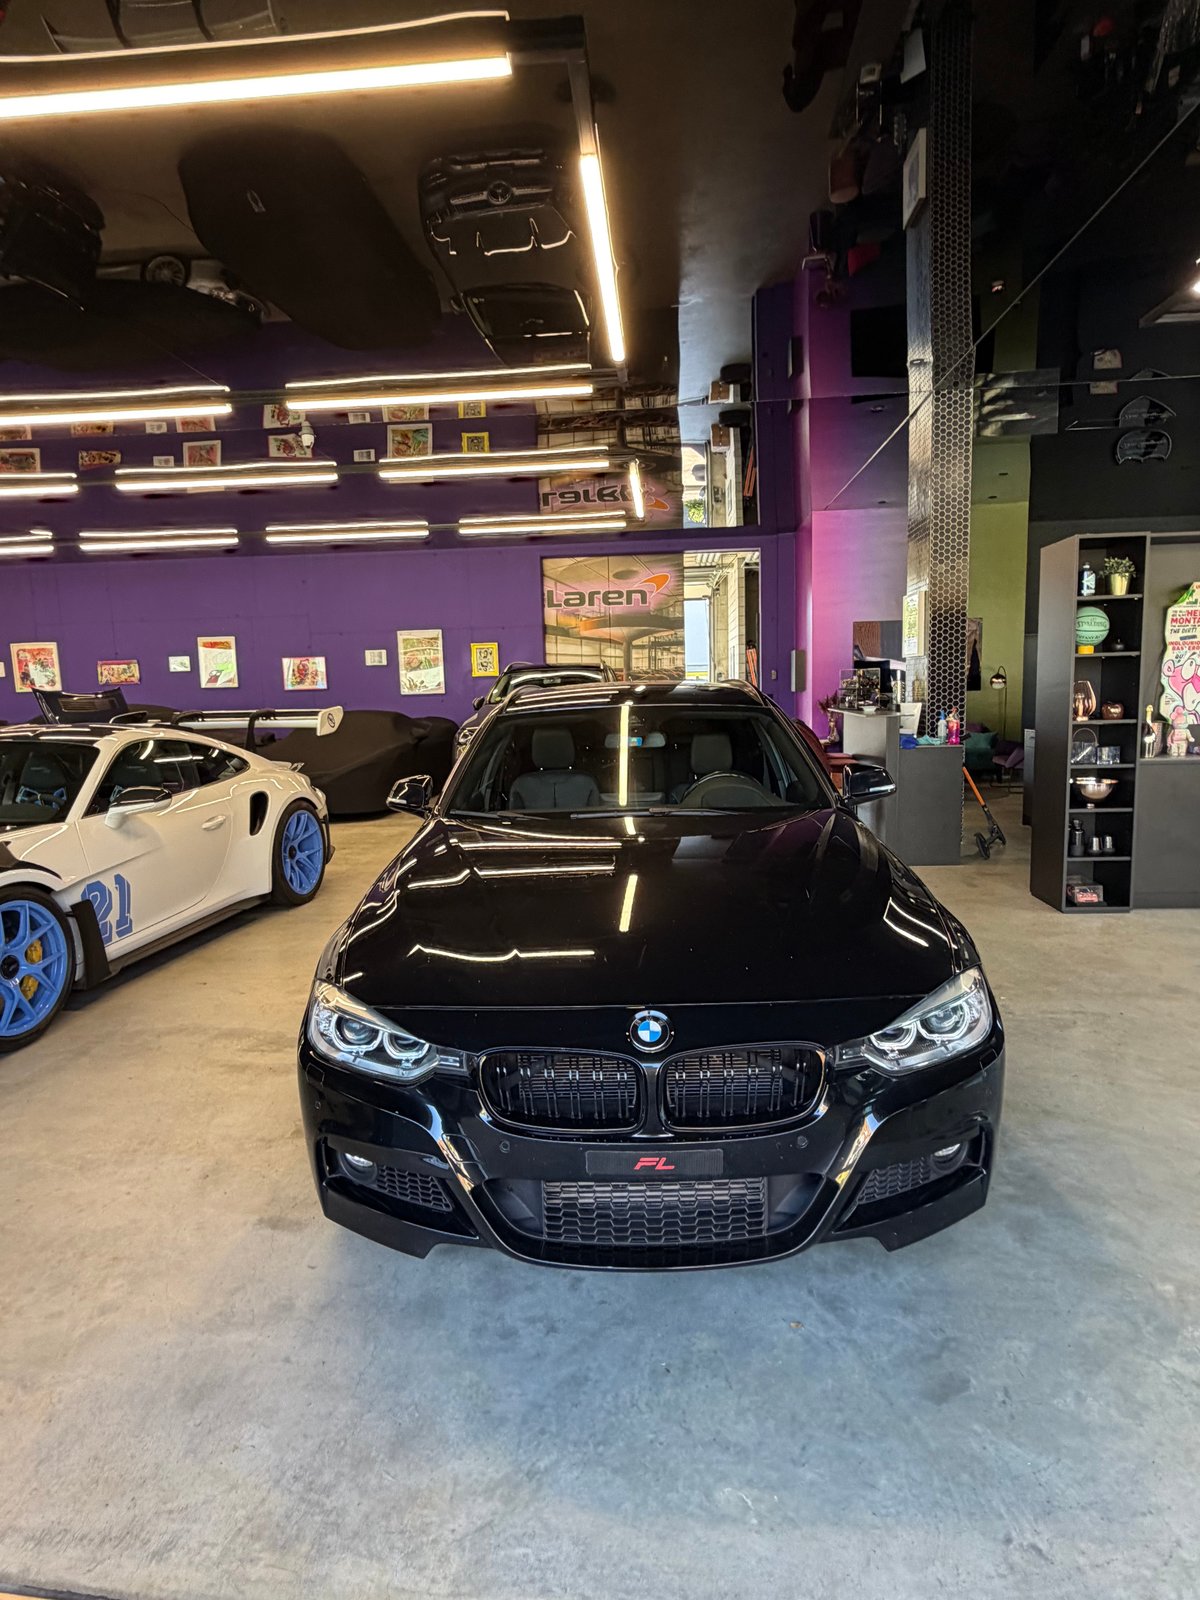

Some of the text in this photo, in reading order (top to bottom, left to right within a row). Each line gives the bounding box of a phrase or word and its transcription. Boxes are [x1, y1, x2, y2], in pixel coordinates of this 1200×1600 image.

[546, 588, 649, 609] Laren
[80, 873, 133, 946] 21
[633, 1157, 676, 1170] FL
